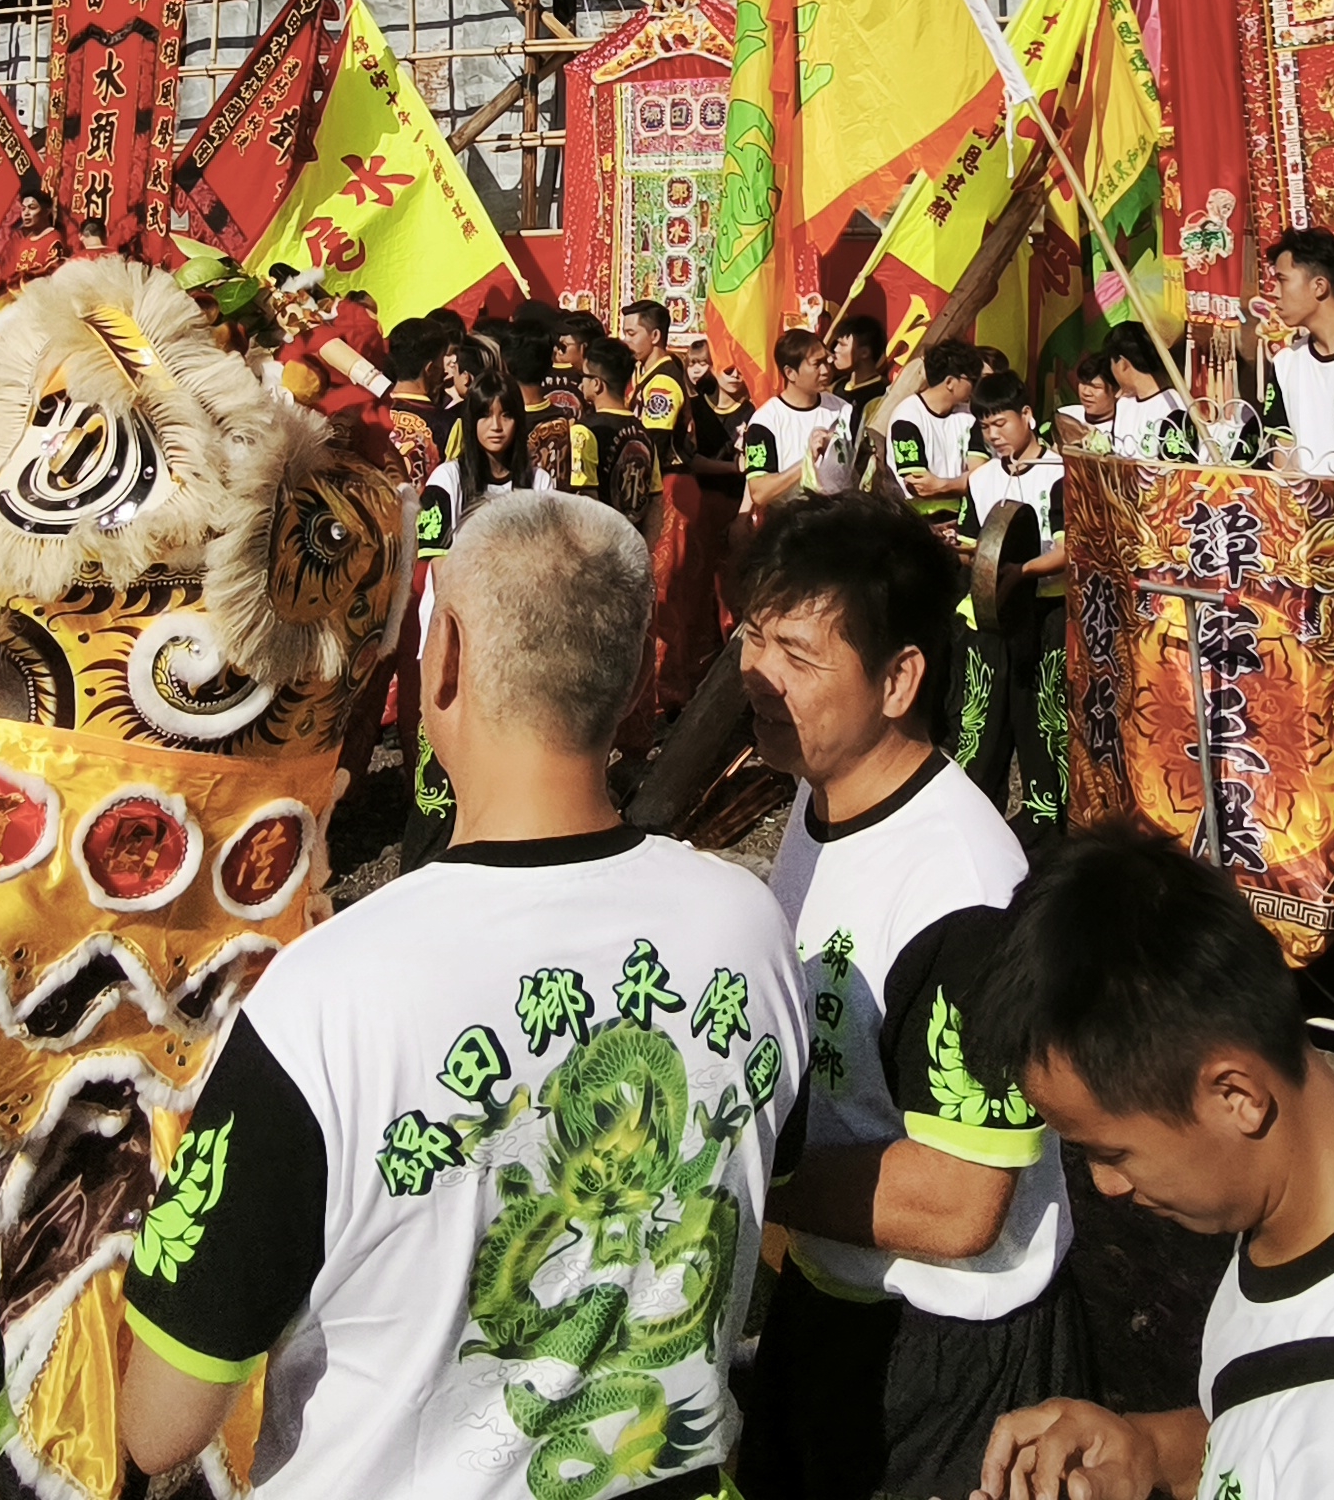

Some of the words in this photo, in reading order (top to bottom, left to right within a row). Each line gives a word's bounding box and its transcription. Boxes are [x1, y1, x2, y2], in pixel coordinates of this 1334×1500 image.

[375, 937, 785, 1198] 錦田鄉永隆圍
[809, 925, 856, 1094] 錦田鄉
